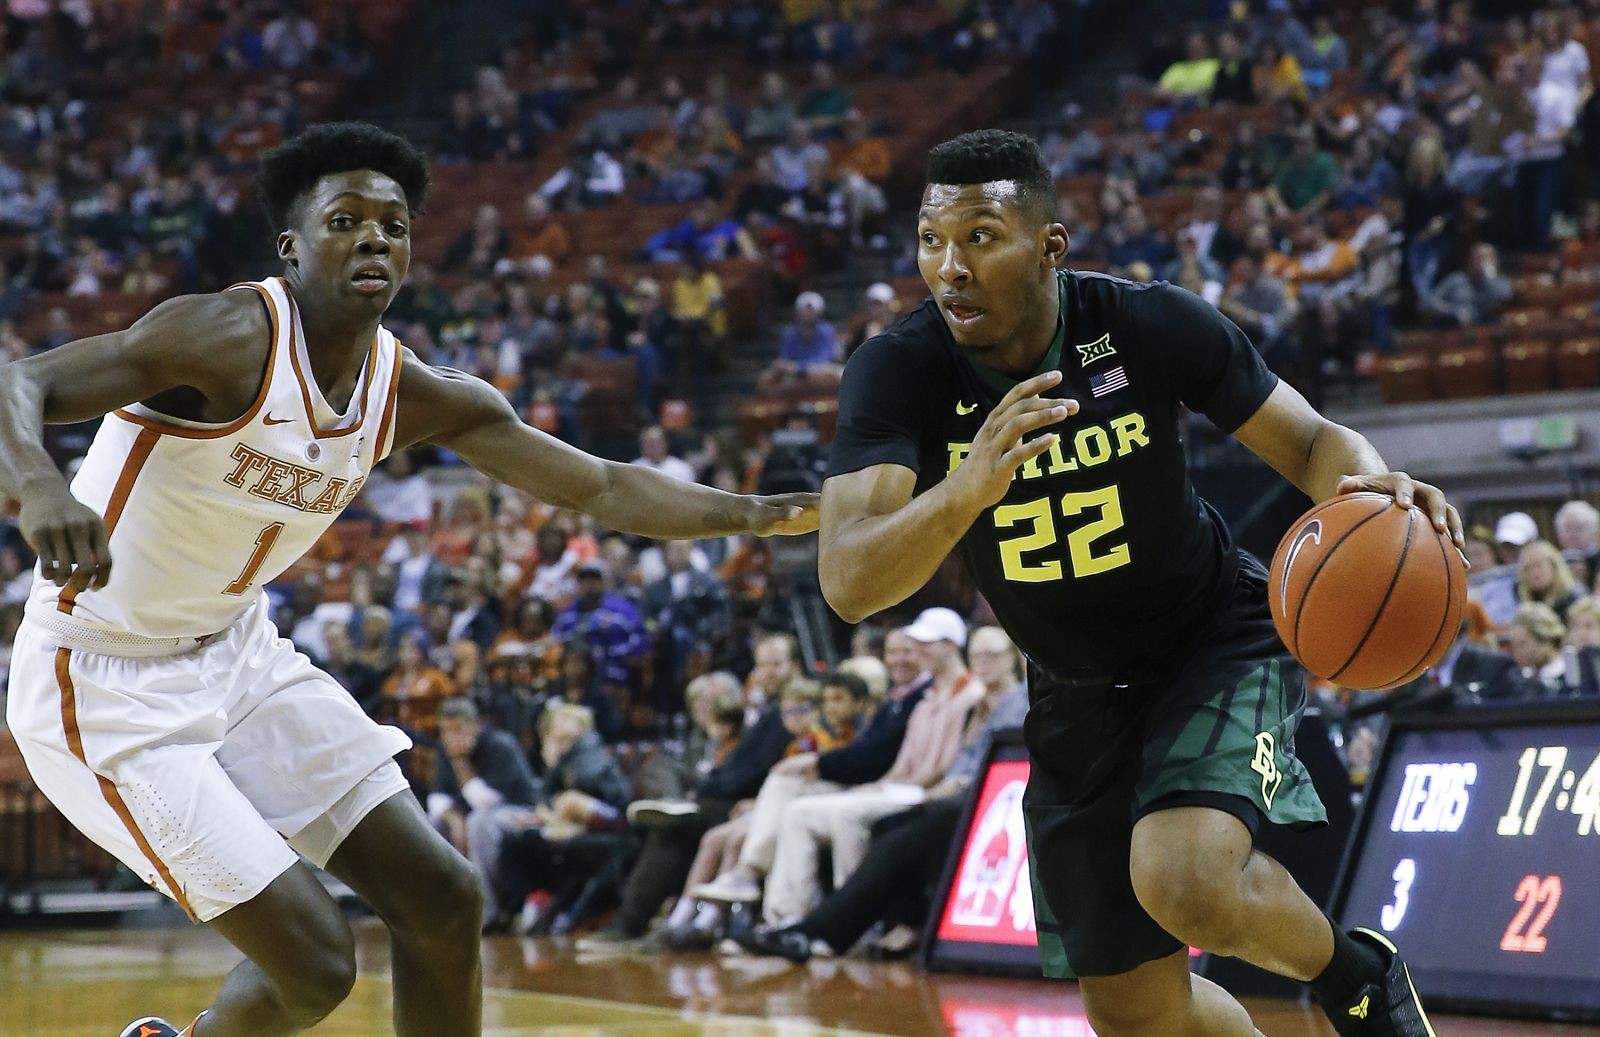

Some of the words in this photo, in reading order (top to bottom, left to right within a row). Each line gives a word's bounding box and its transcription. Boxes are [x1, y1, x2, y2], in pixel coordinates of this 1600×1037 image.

[223, 442, 364, 514] TEXAS
[947, 412, 1150, 480] LOR
[221, 521, 285, 596] 1
[993, 484, 1131, 582] 22
[1390, 762, 1477, 832] TEXAS
[1496, 745, 1600, 836] 17:4
[1381, 858, 1416, 932] 3
[1500, 873, 1562, 953] 22
